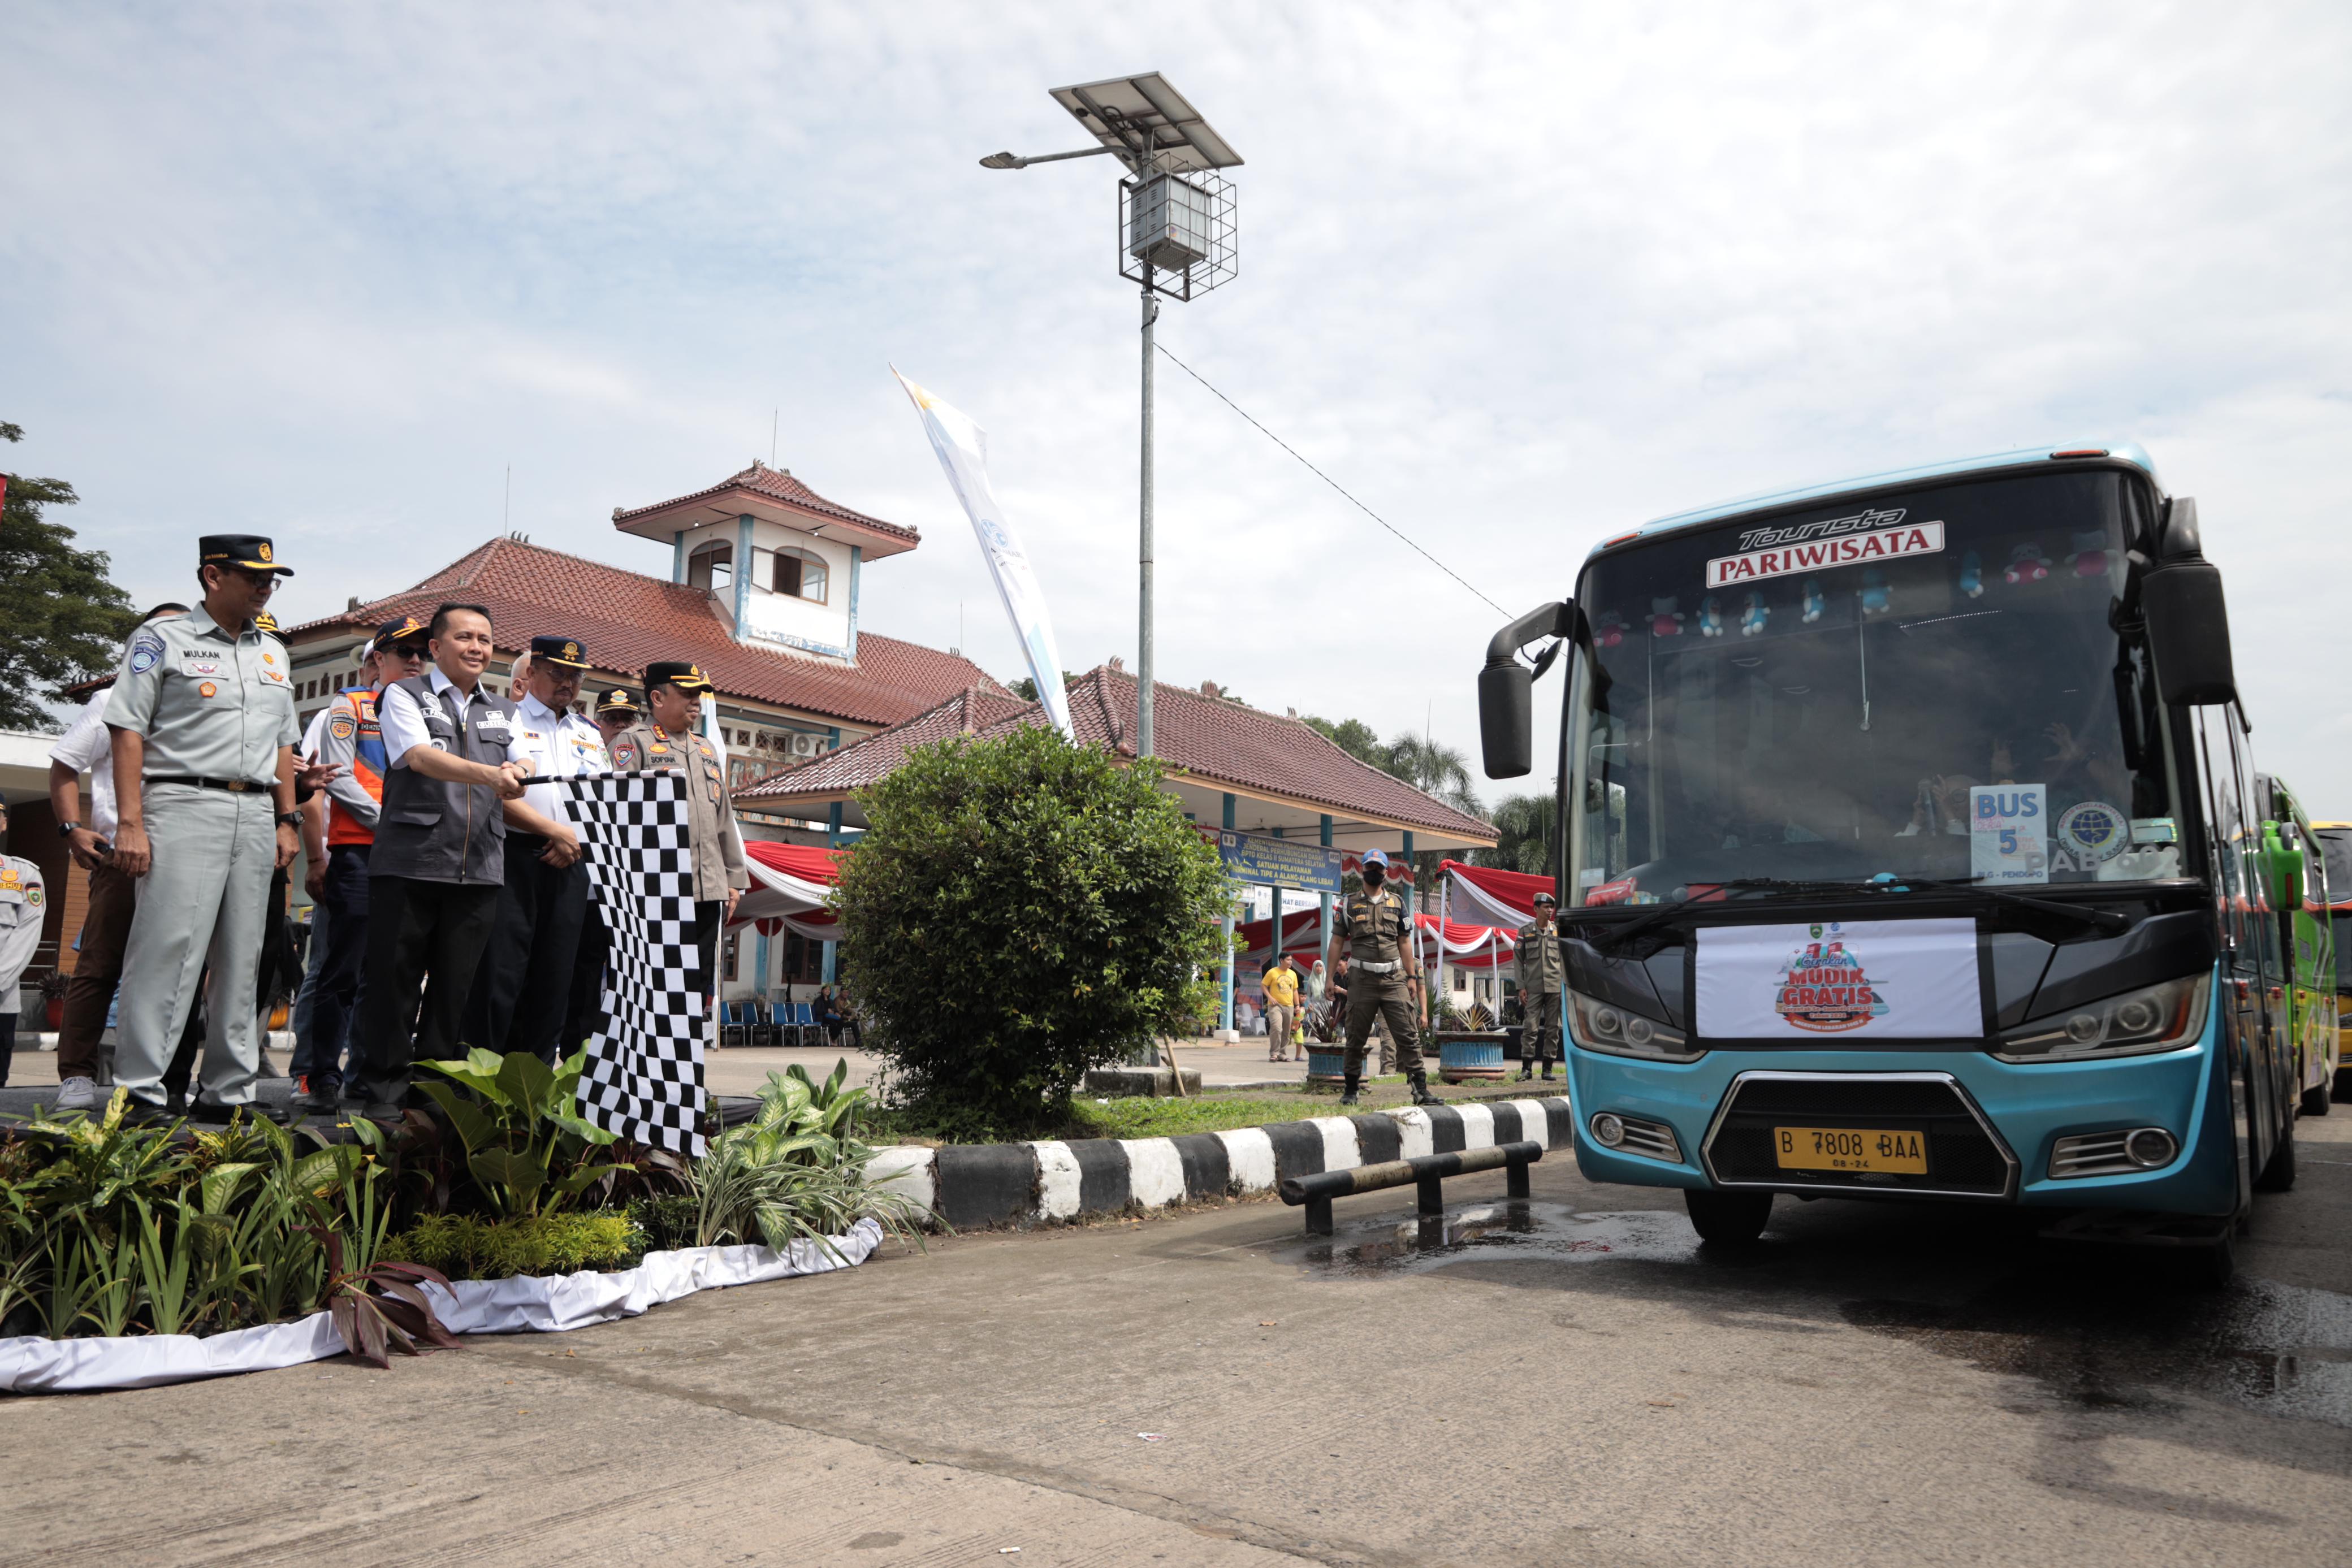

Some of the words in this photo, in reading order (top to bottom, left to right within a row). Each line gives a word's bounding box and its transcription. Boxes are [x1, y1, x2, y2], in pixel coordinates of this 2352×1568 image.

[1739, 508, 1907, 551] Tourista
[1719, 529, 1930, 582] PARIWISATA
[183, 650, 220, 660] MULKAN
[1977, 792, 2039, 818] BUS
[1247, 837, 1283, 847] KEMENTERIAN
[1284, 843, 1321, 854] PERHUBUNGAN
[1999, 829, 2017, 854] 5
[1243, 843, 1270, 852] JENDERAL
[1271, 847, 1307, 859] PERHUBUNGAN
[1256, 852, 1273, 860] KELAS
[1278, 855, 1304, 865] SUMATERA
[1304, 859, 1326, 868] SELATAN
[1257, 860, 1279, 870] SATUAN
[1280, 864, 1312, 875] PELAYANAN
[2026, 849, 2102, 876] PAB
[2117, 846, 2182, 872] 602
[1260, 869, 1273, 878] TIPE
[1279, 872, 1317, 884] ALANG-ALANG
[1318, 877, 1334, 886] LEBAR
[1801, 953, 1848, 969] Gerakan
[1788, 967, 1865, 985] MUDIK
[1783, 987, 1873, 1006] GRATIS
[1793, 1019, 1822, 1030] ANGKUTAN
[1782, 1131, 1793, 1153] B
[1811, 1132, 1864, 1156] 7808
[1880, 1134, 1921, 1159] BAA
